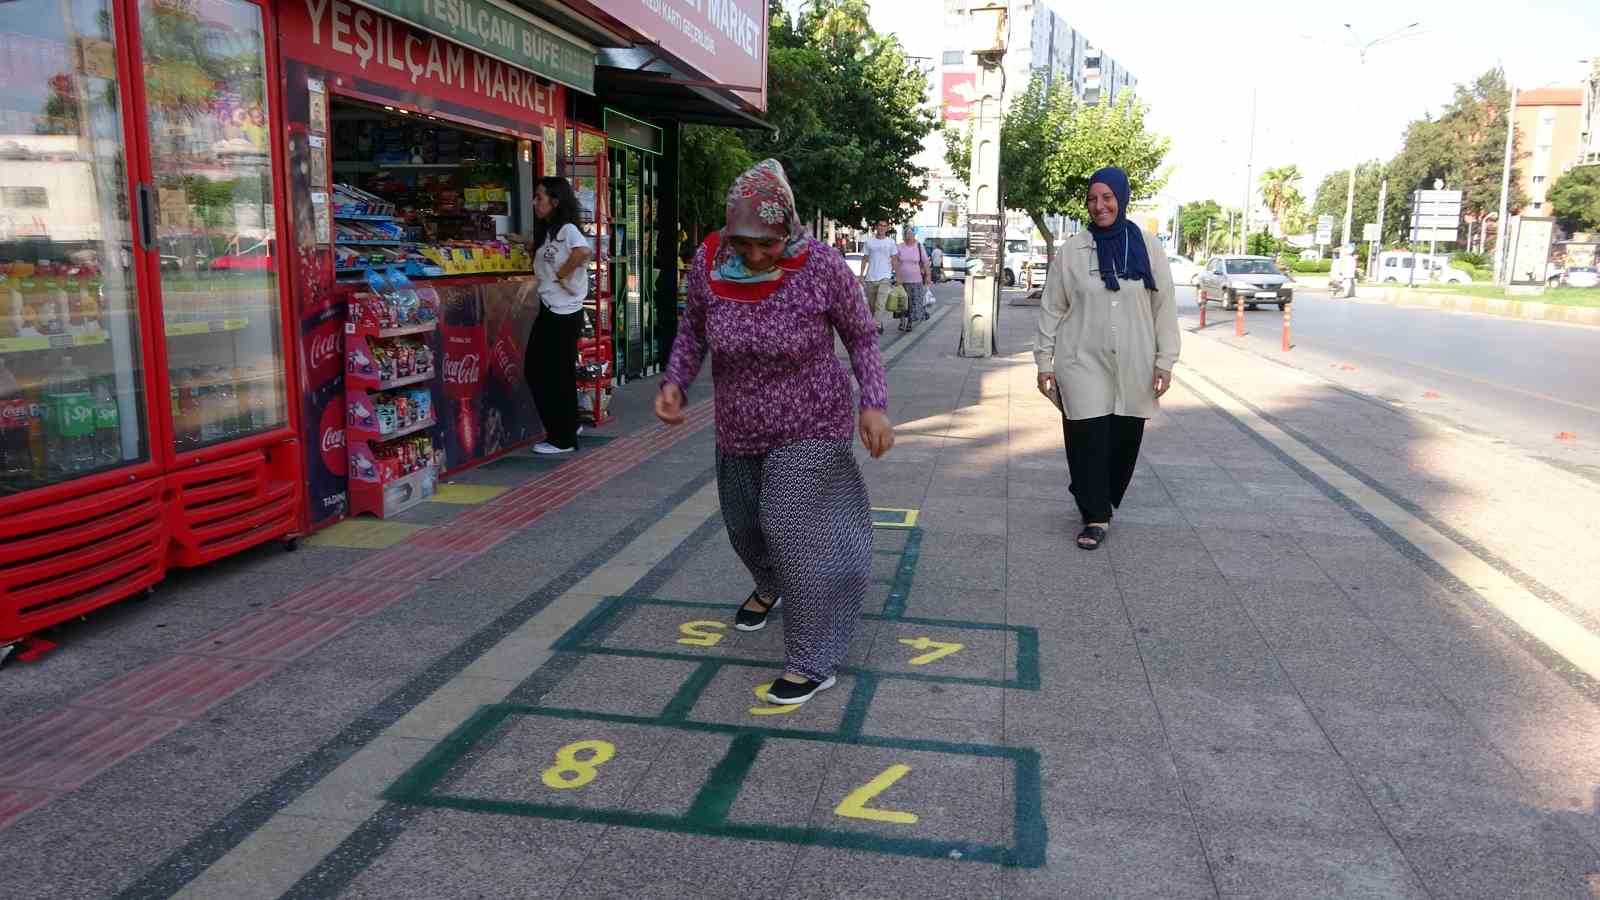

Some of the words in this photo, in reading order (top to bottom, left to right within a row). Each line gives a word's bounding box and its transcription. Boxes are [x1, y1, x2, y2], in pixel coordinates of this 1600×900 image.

[521, 28, 561, 73] BÜFE
[707, 0, 760, 60] MARKET
[473, 55, 558, 117] MARKET
[441, 352, 480, 384] Coca-Cola
[677, 620, 728, 646] 5
[898, 636, 965, 666] 4
[540, 739, 617, 790] 8
[833, 763, 920, 825] 7
